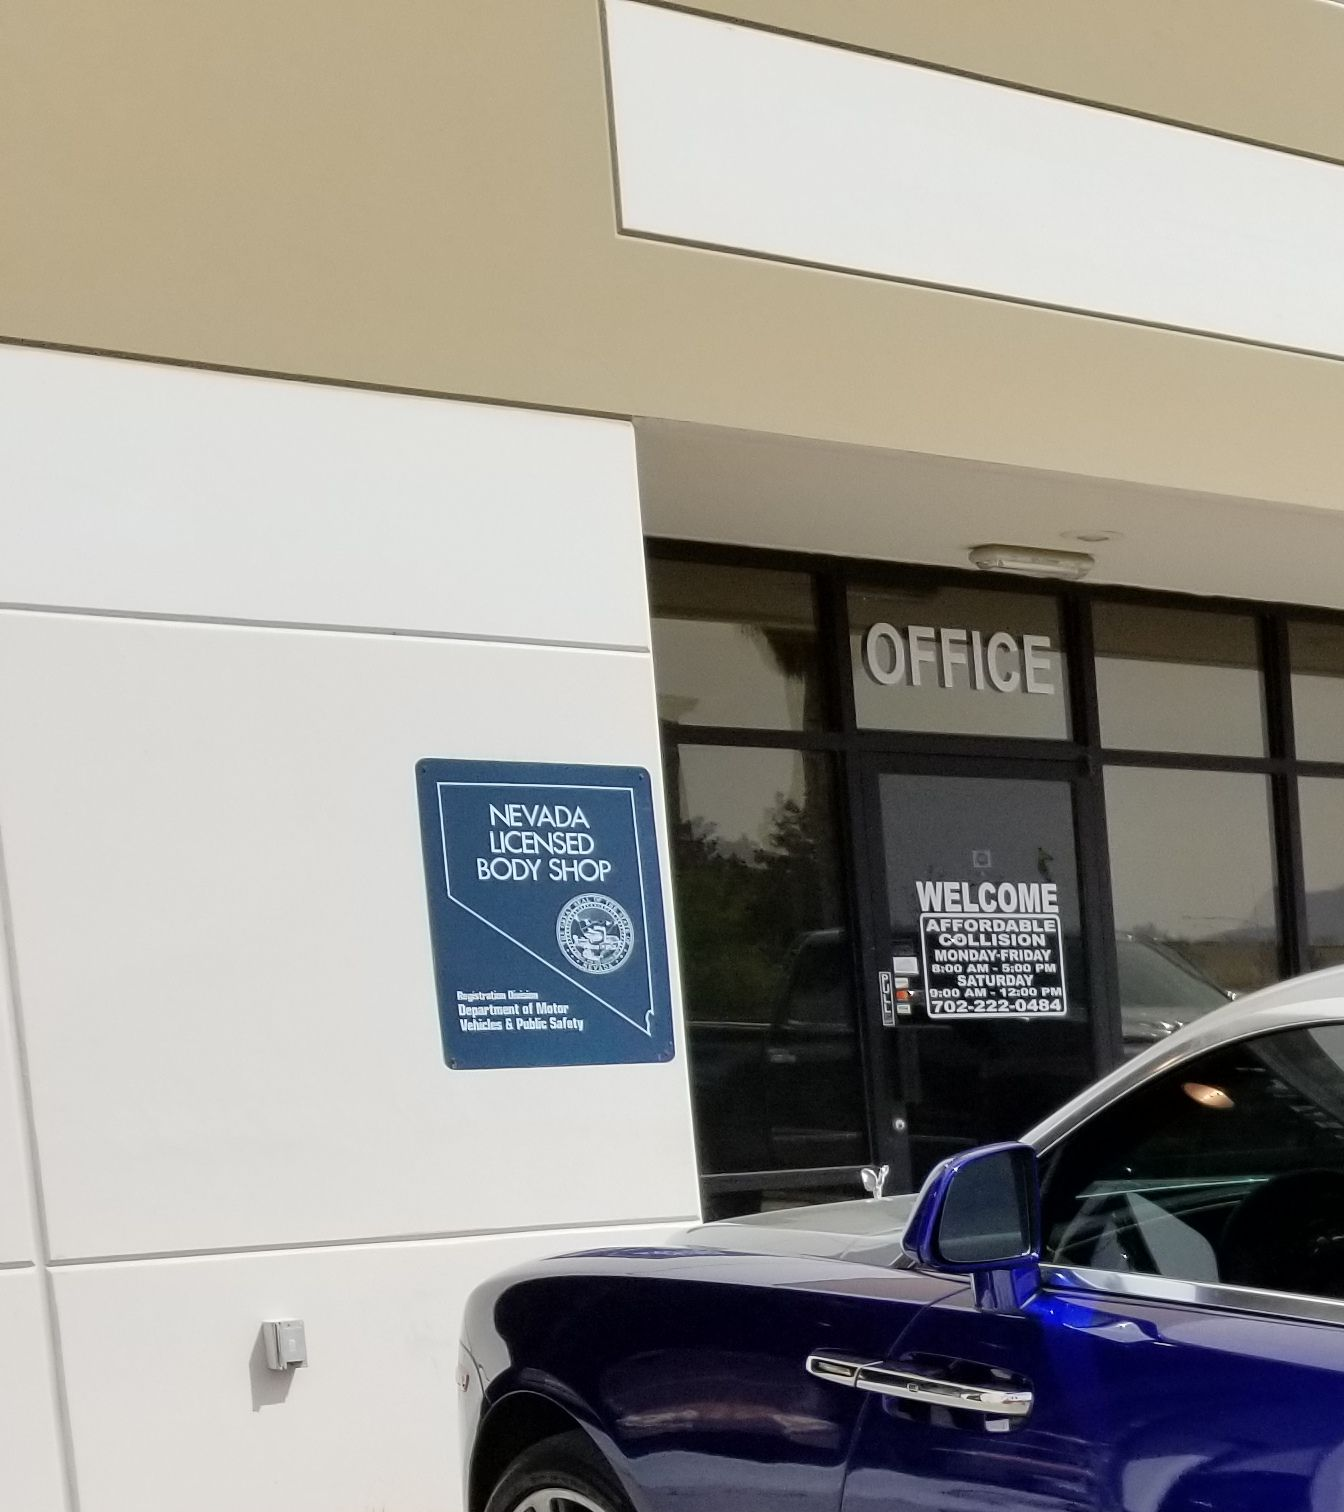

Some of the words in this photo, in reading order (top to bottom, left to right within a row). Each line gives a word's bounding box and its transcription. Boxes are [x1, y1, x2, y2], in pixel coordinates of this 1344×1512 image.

[866, 622, 1055, 695] OFFICE
[489, 803, 591, 829] NEVADA
[489, 830, 595, 855] LICENSED
[476, 857, 541, 881] BODY
[548, 858, 612, 882] SHOP
[915, 881, 1060, 913] WELCOME
[926, 918, 1057, 933] AFFORDABLE
[938, 933, 1047, 947] COLLISION
[934, 949, 1052, 962] MONDAY-FRIDAY
[931, 963, 963, 974] 8:00
[966, 963, 989, 973] AM
[1001, 963, 1032, 973] 5:00
[1035, 963, 1057, 973] PM
[957, 974, 1034, 987] SATURDAY
[964, 988, 987, 998] AM
[999, 988, 1038, 998] 12:00
[1041, 987, 1062, 997] PM
[458, 1003, 520, 1018] Department
[522, 1003, 534, 1015] of
[535, 1002, 569, 1015] Motor
[931, 998, 1062, 1013] 702-222-0484
[459, 1018, 503, 1031] Vehicles
[505, 1017, 514, 1030] &
[516, 1017, 548, 1030] Public
[549, 1017, 584, 1032] Safety
